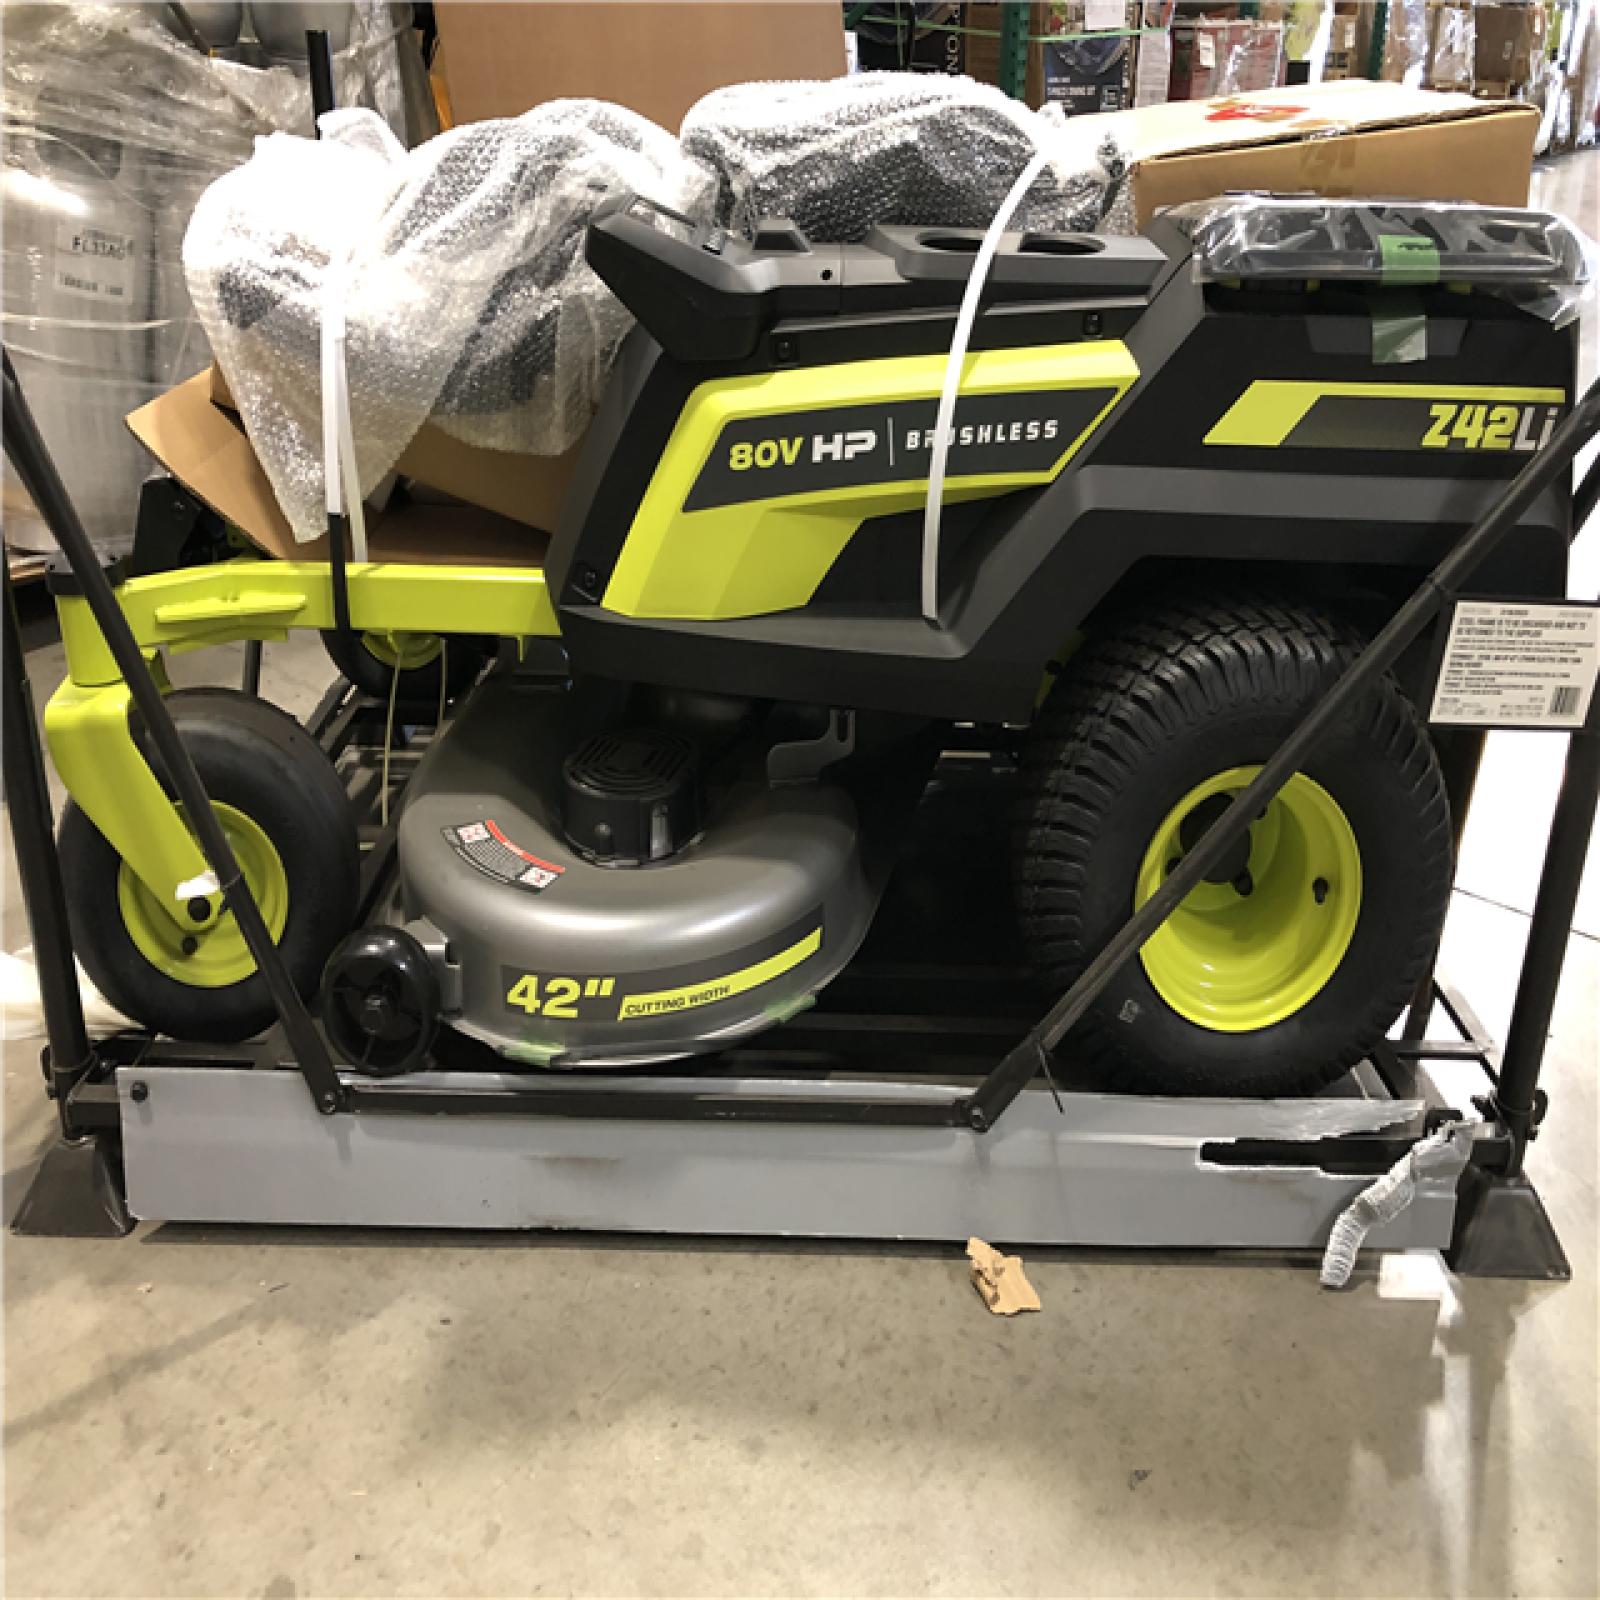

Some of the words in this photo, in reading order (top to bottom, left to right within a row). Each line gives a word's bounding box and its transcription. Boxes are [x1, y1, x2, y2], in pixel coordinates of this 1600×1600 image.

[729, 437, 803, 470] 80V
[812, 430, 877, 462] HP
[507, 974, 616, 1019] 42"
[624, 996, 686, 1016] CUTTING
[689, 984, 731, 1004] WIDTH
